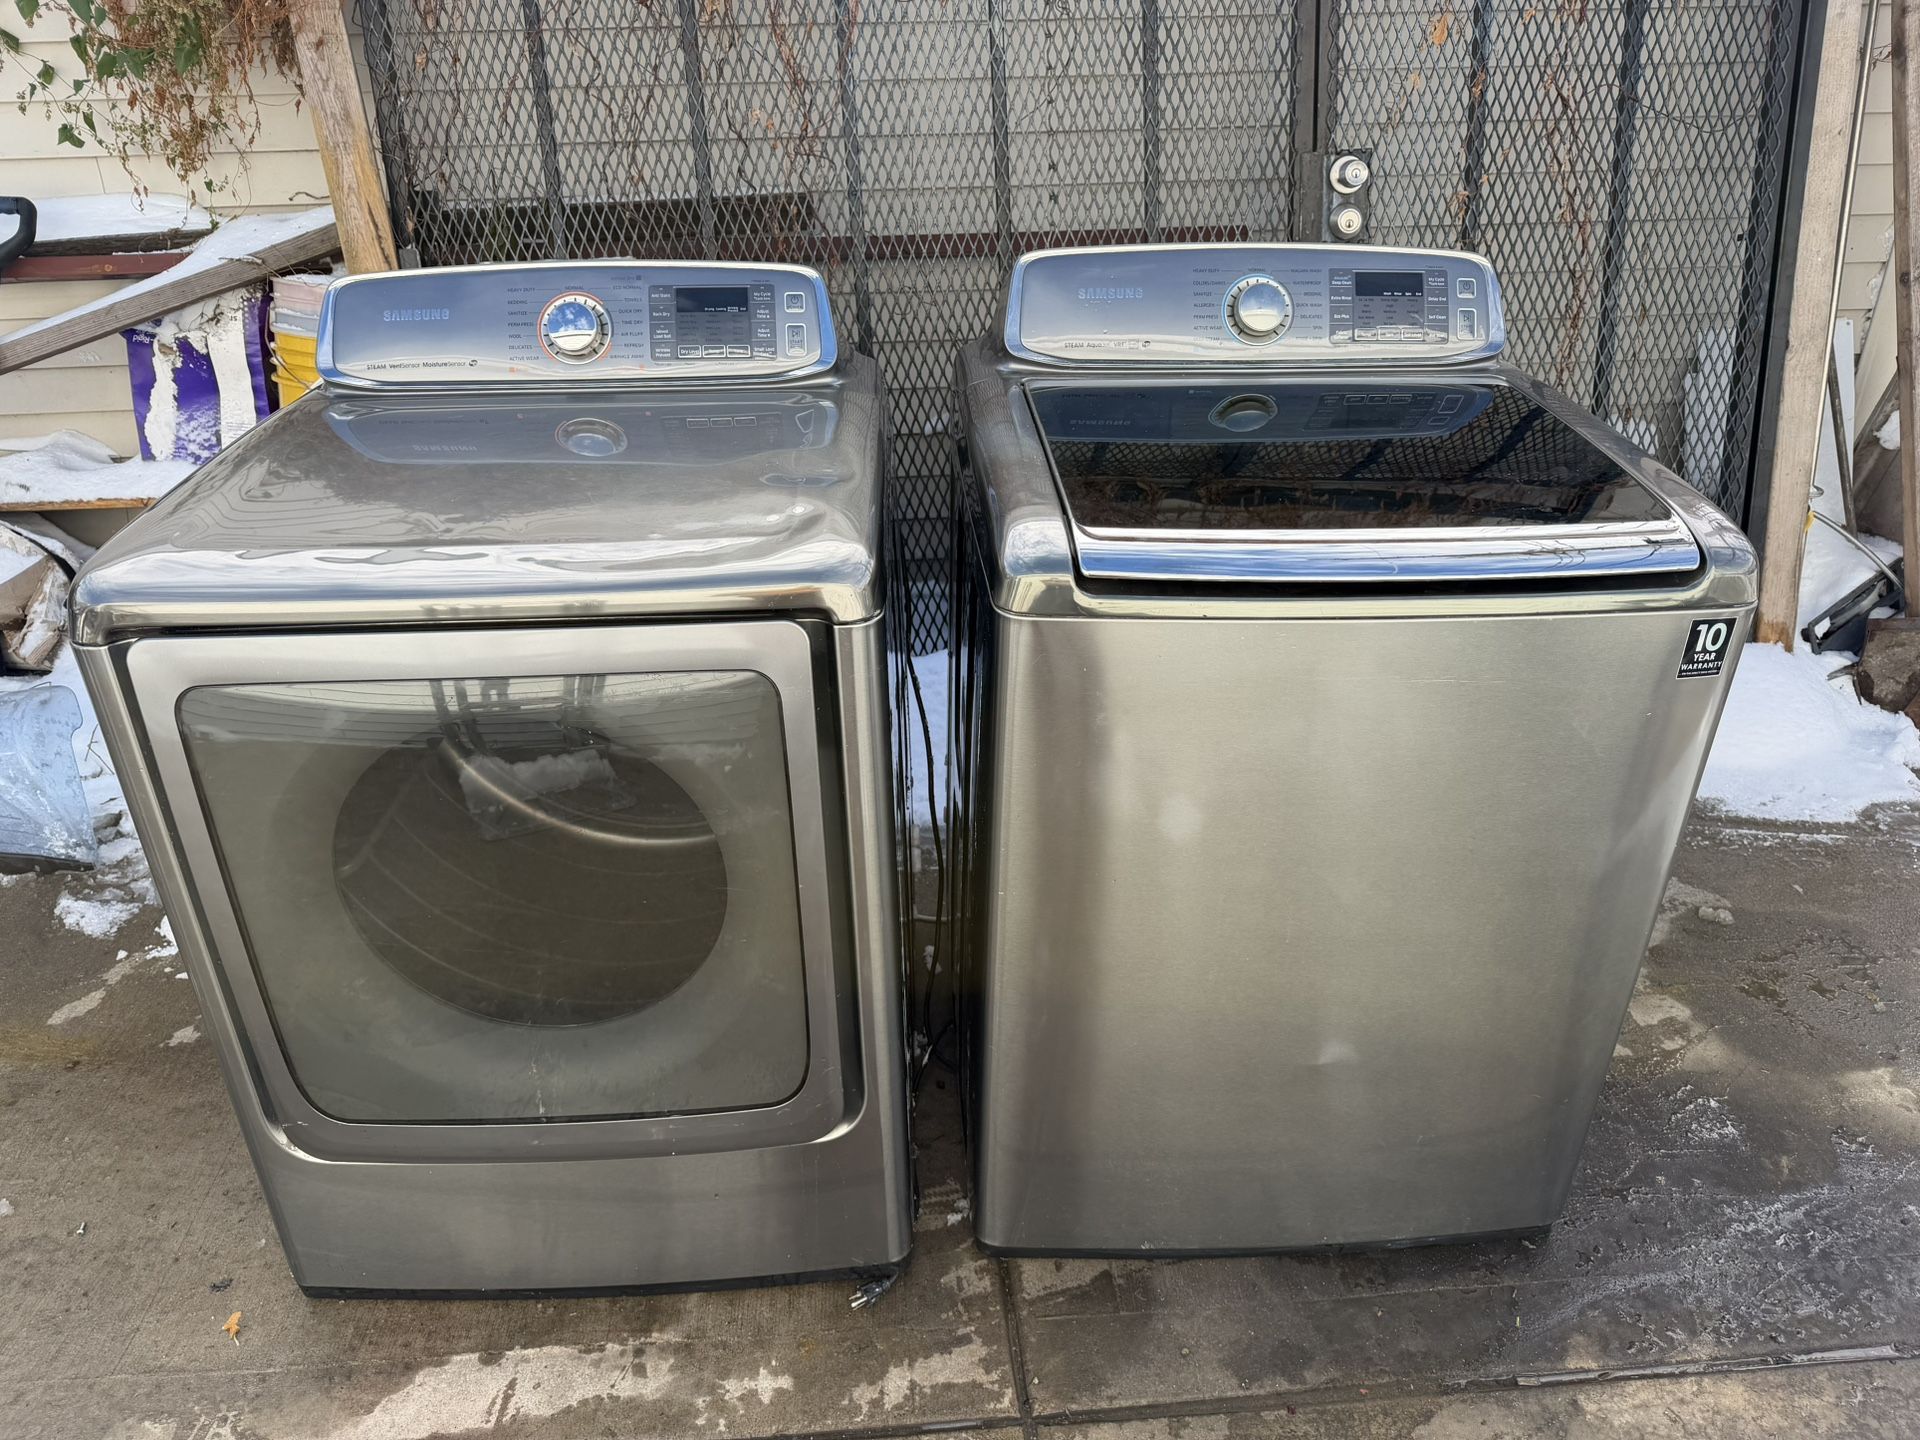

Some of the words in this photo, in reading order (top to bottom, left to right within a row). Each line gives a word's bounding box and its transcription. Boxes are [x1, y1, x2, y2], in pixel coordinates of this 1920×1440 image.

[1078, 287, 1143, 300] SAMSUNG
[383, 308, 450, 322] SAMSUNG
[1696, 622, 1727, 652] 10
[1694, 652, 1716, 662] YEAR
[1681, 661, 1723, 670] WARRANTY
